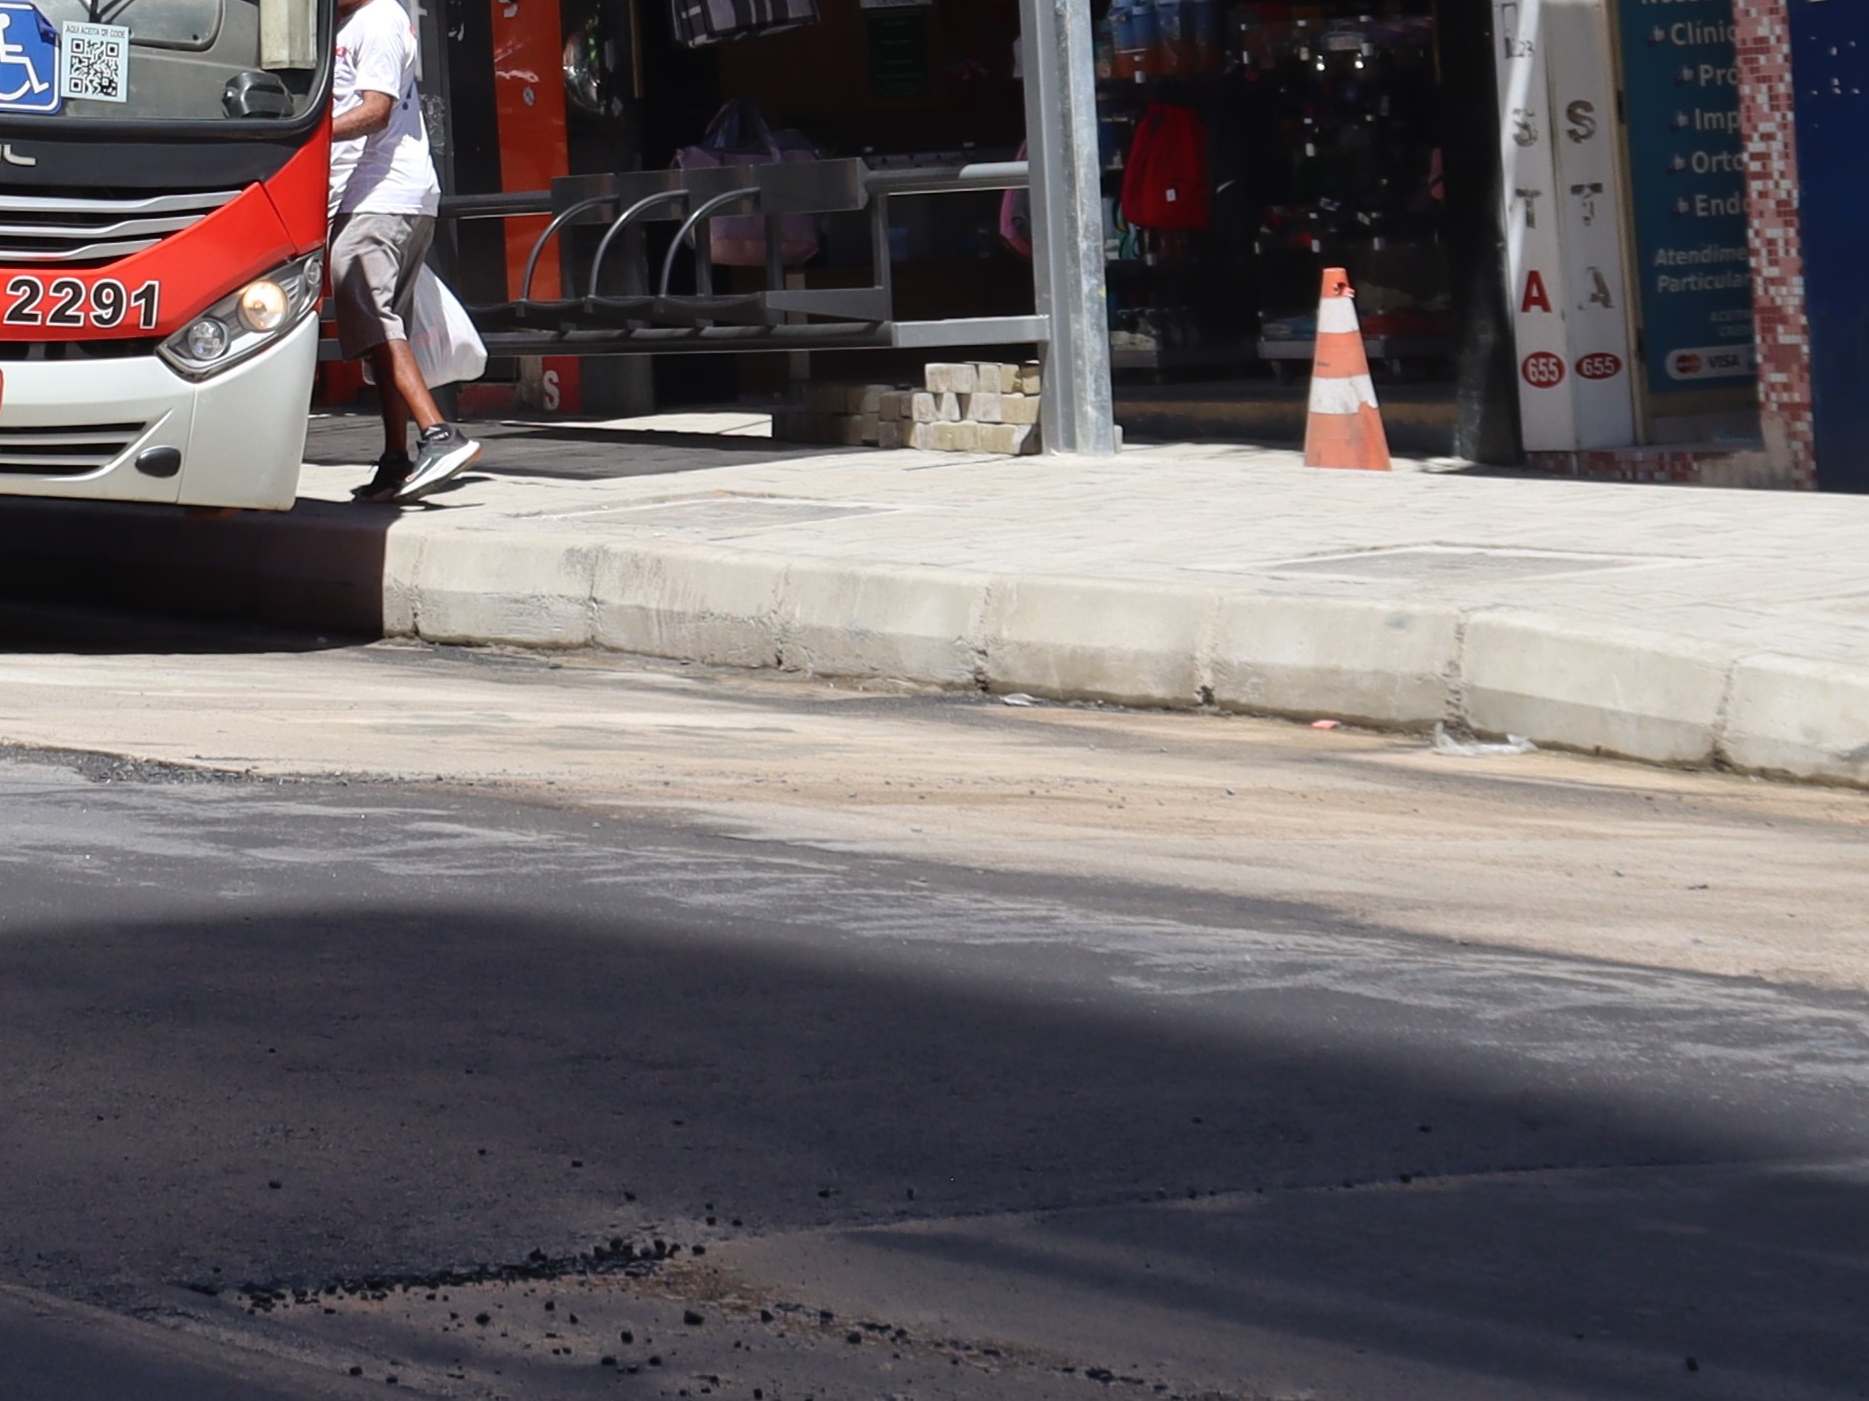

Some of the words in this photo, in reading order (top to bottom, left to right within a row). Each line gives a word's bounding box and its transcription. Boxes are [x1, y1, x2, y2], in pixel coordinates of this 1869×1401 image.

[3, 275, 161, 329] 2291
[1526, 354, 1560, 386] 655
[1581, 356, 1616, 376] 655
